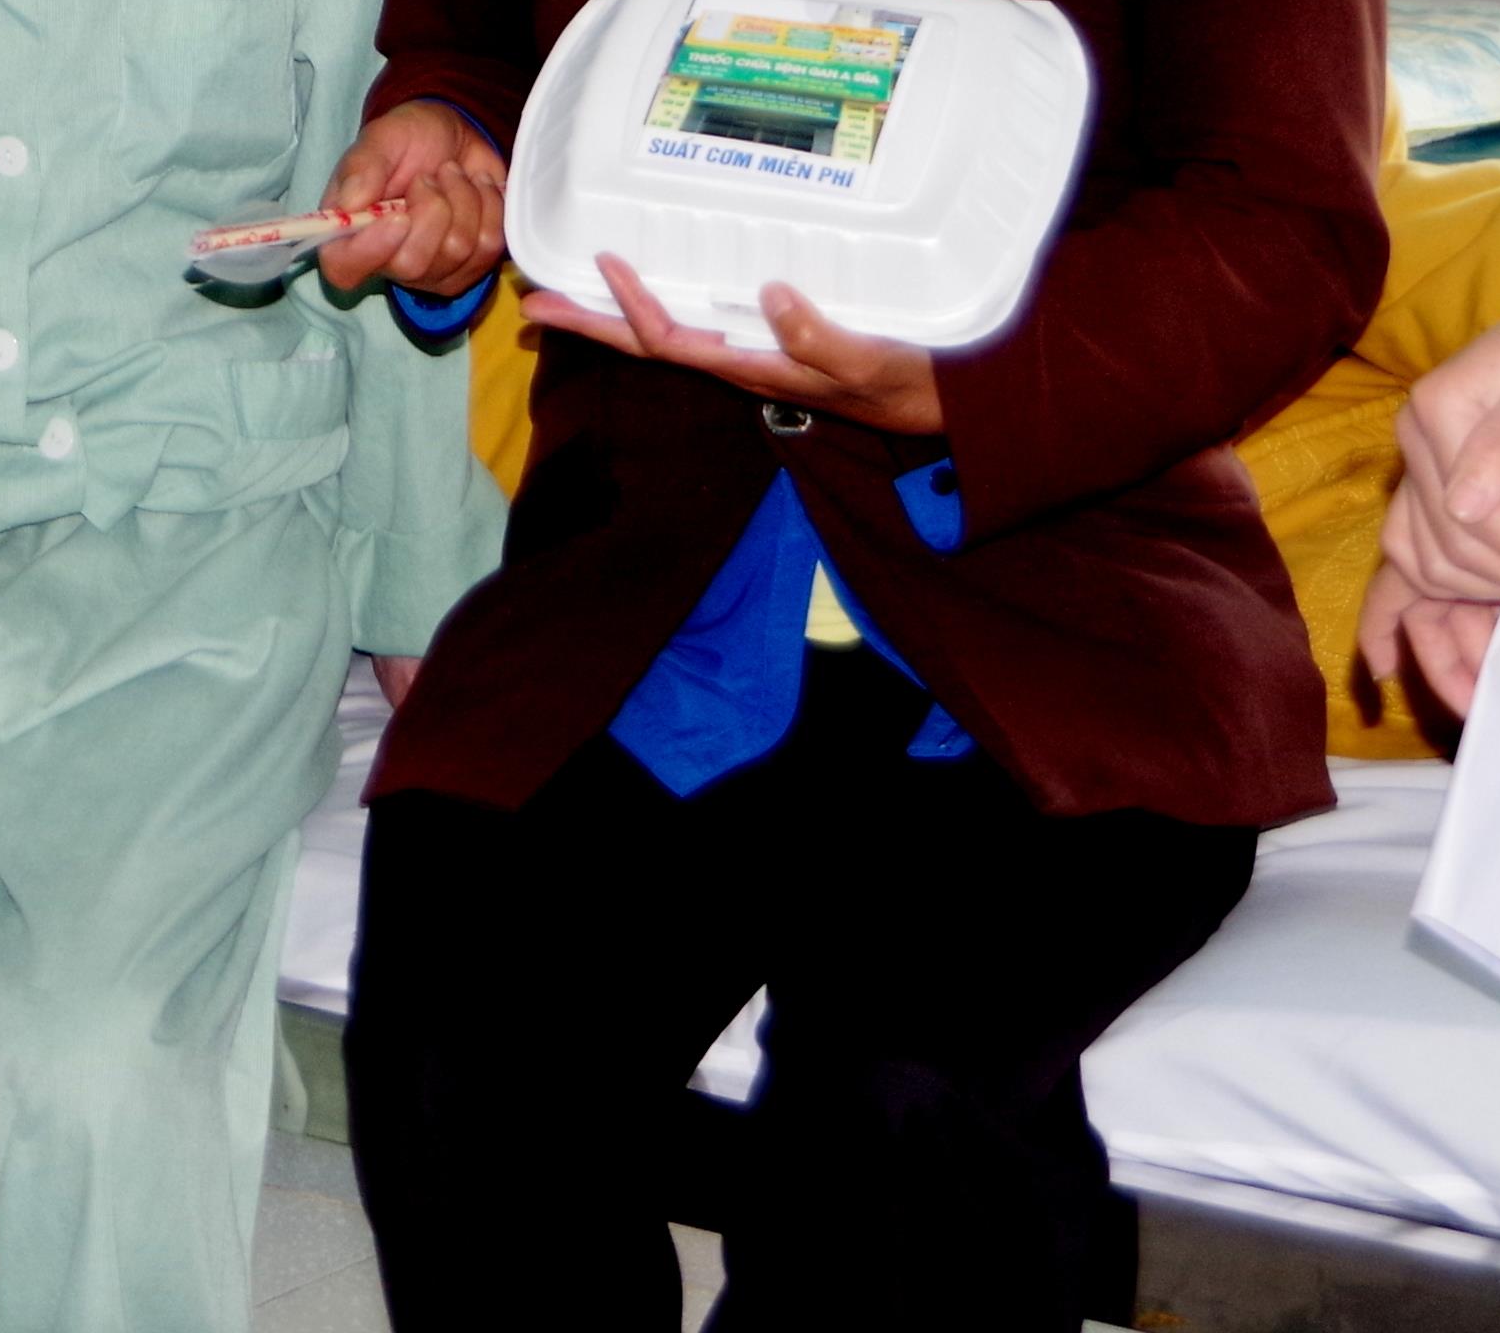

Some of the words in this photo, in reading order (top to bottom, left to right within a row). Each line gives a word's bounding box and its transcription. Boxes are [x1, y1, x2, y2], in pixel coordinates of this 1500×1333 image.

[649, 136, 702, 159] SUẤT
[706, 146, 753, 169] CƠM
[818, 166, 854, 188] PHÍ
